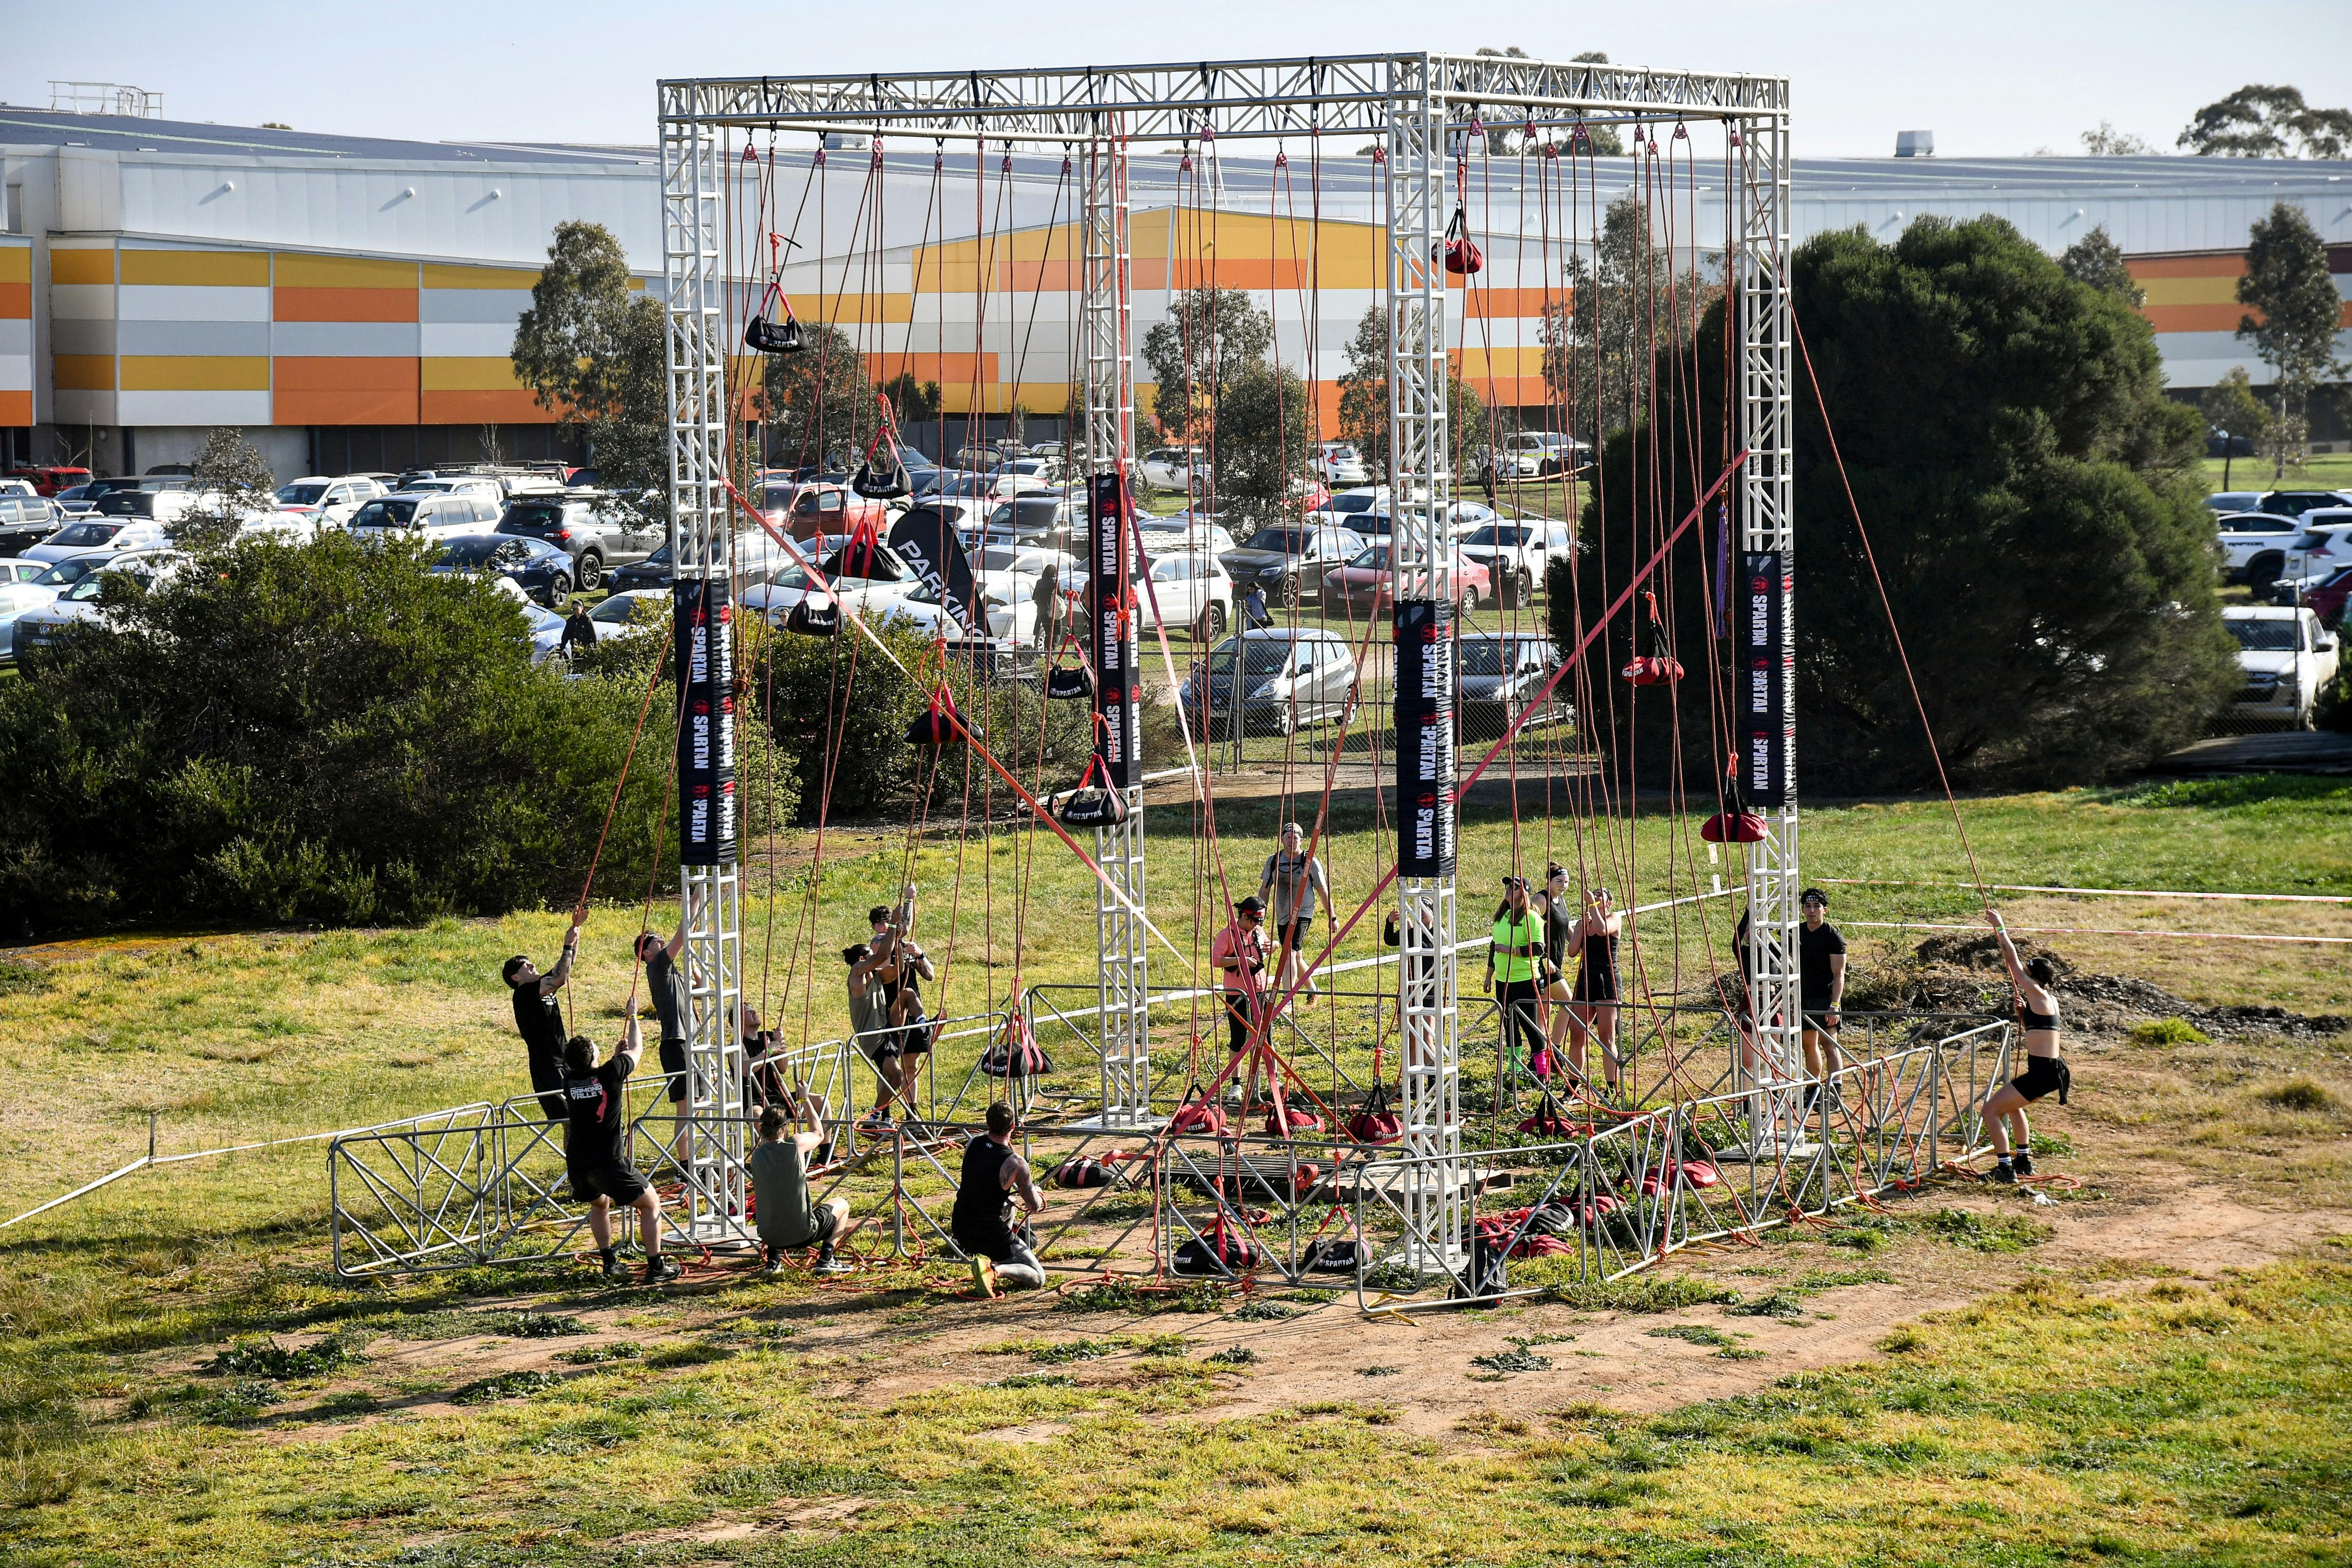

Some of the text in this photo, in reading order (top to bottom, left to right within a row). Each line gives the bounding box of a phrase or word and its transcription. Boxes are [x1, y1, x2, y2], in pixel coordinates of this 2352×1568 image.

[1102, 516, 1116, 574] SPARTAN
[1104, 611, 1118, 669] SPARTAN
[1129, 609, 1138, 668] SPARTAN
[1752, 595, 1767, 645] SPARTAN
[691, 626, 706, 683] SPARTAN
[719, 625, 731, 681] SPARTAN
[1422, 644, 1437, 698] SPARTAN
[1056, 686, 1081, 696] SPARTAN
[693, 716, 708, 768] SPARTAN
[1106, 705, 1120, 762] SPARTAN
[1131, 702, 1140, 760] SPARTAN
[1419, 726, 1436, 780] SPARTAN
[1327, 765, 1336, 780] SPARTAN
[1073, 810, 1103, 820] SPARTAN
[1415, 809, 1433, 859] SPARTAN
[1269, 988, 1277, 1003] SPARTAN
[571, 1085, 602, 1095] DIAMOND
[572, 1090, 602, 1100] VALLEY
[1186, 1122, 1206, 1131] ARTAN
[1325, 1257, 1354, 1267] SPARTAN
